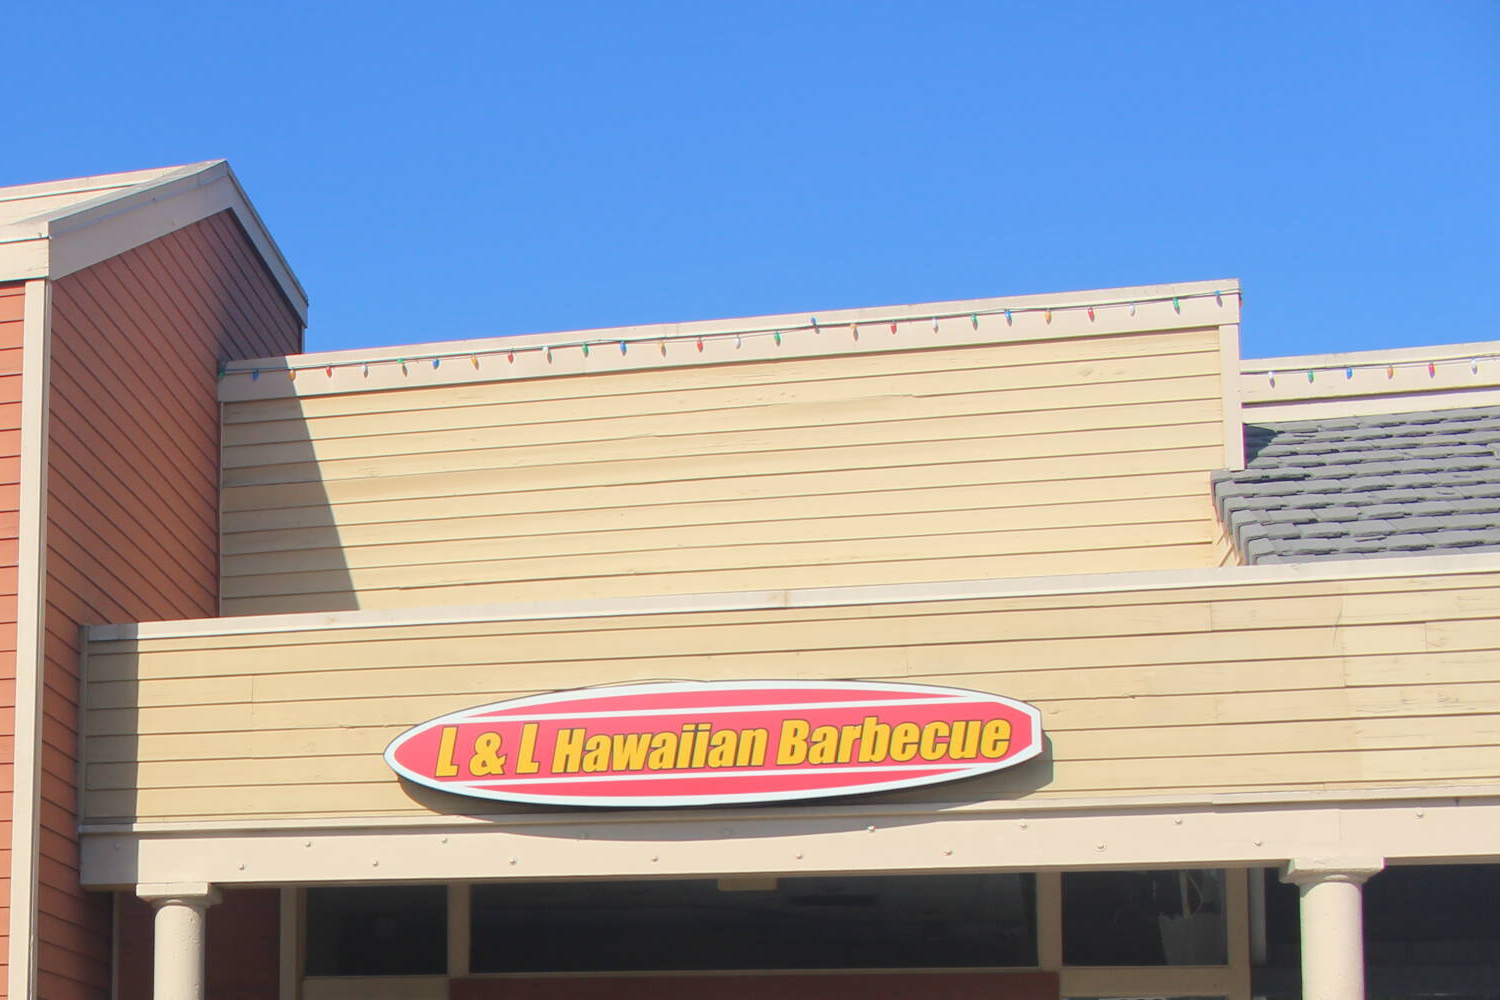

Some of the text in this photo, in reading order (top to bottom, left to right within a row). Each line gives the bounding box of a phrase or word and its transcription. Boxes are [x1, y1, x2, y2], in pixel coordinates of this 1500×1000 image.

[435, 715, 1012, 778] L & L Hawaiian Barbecue
